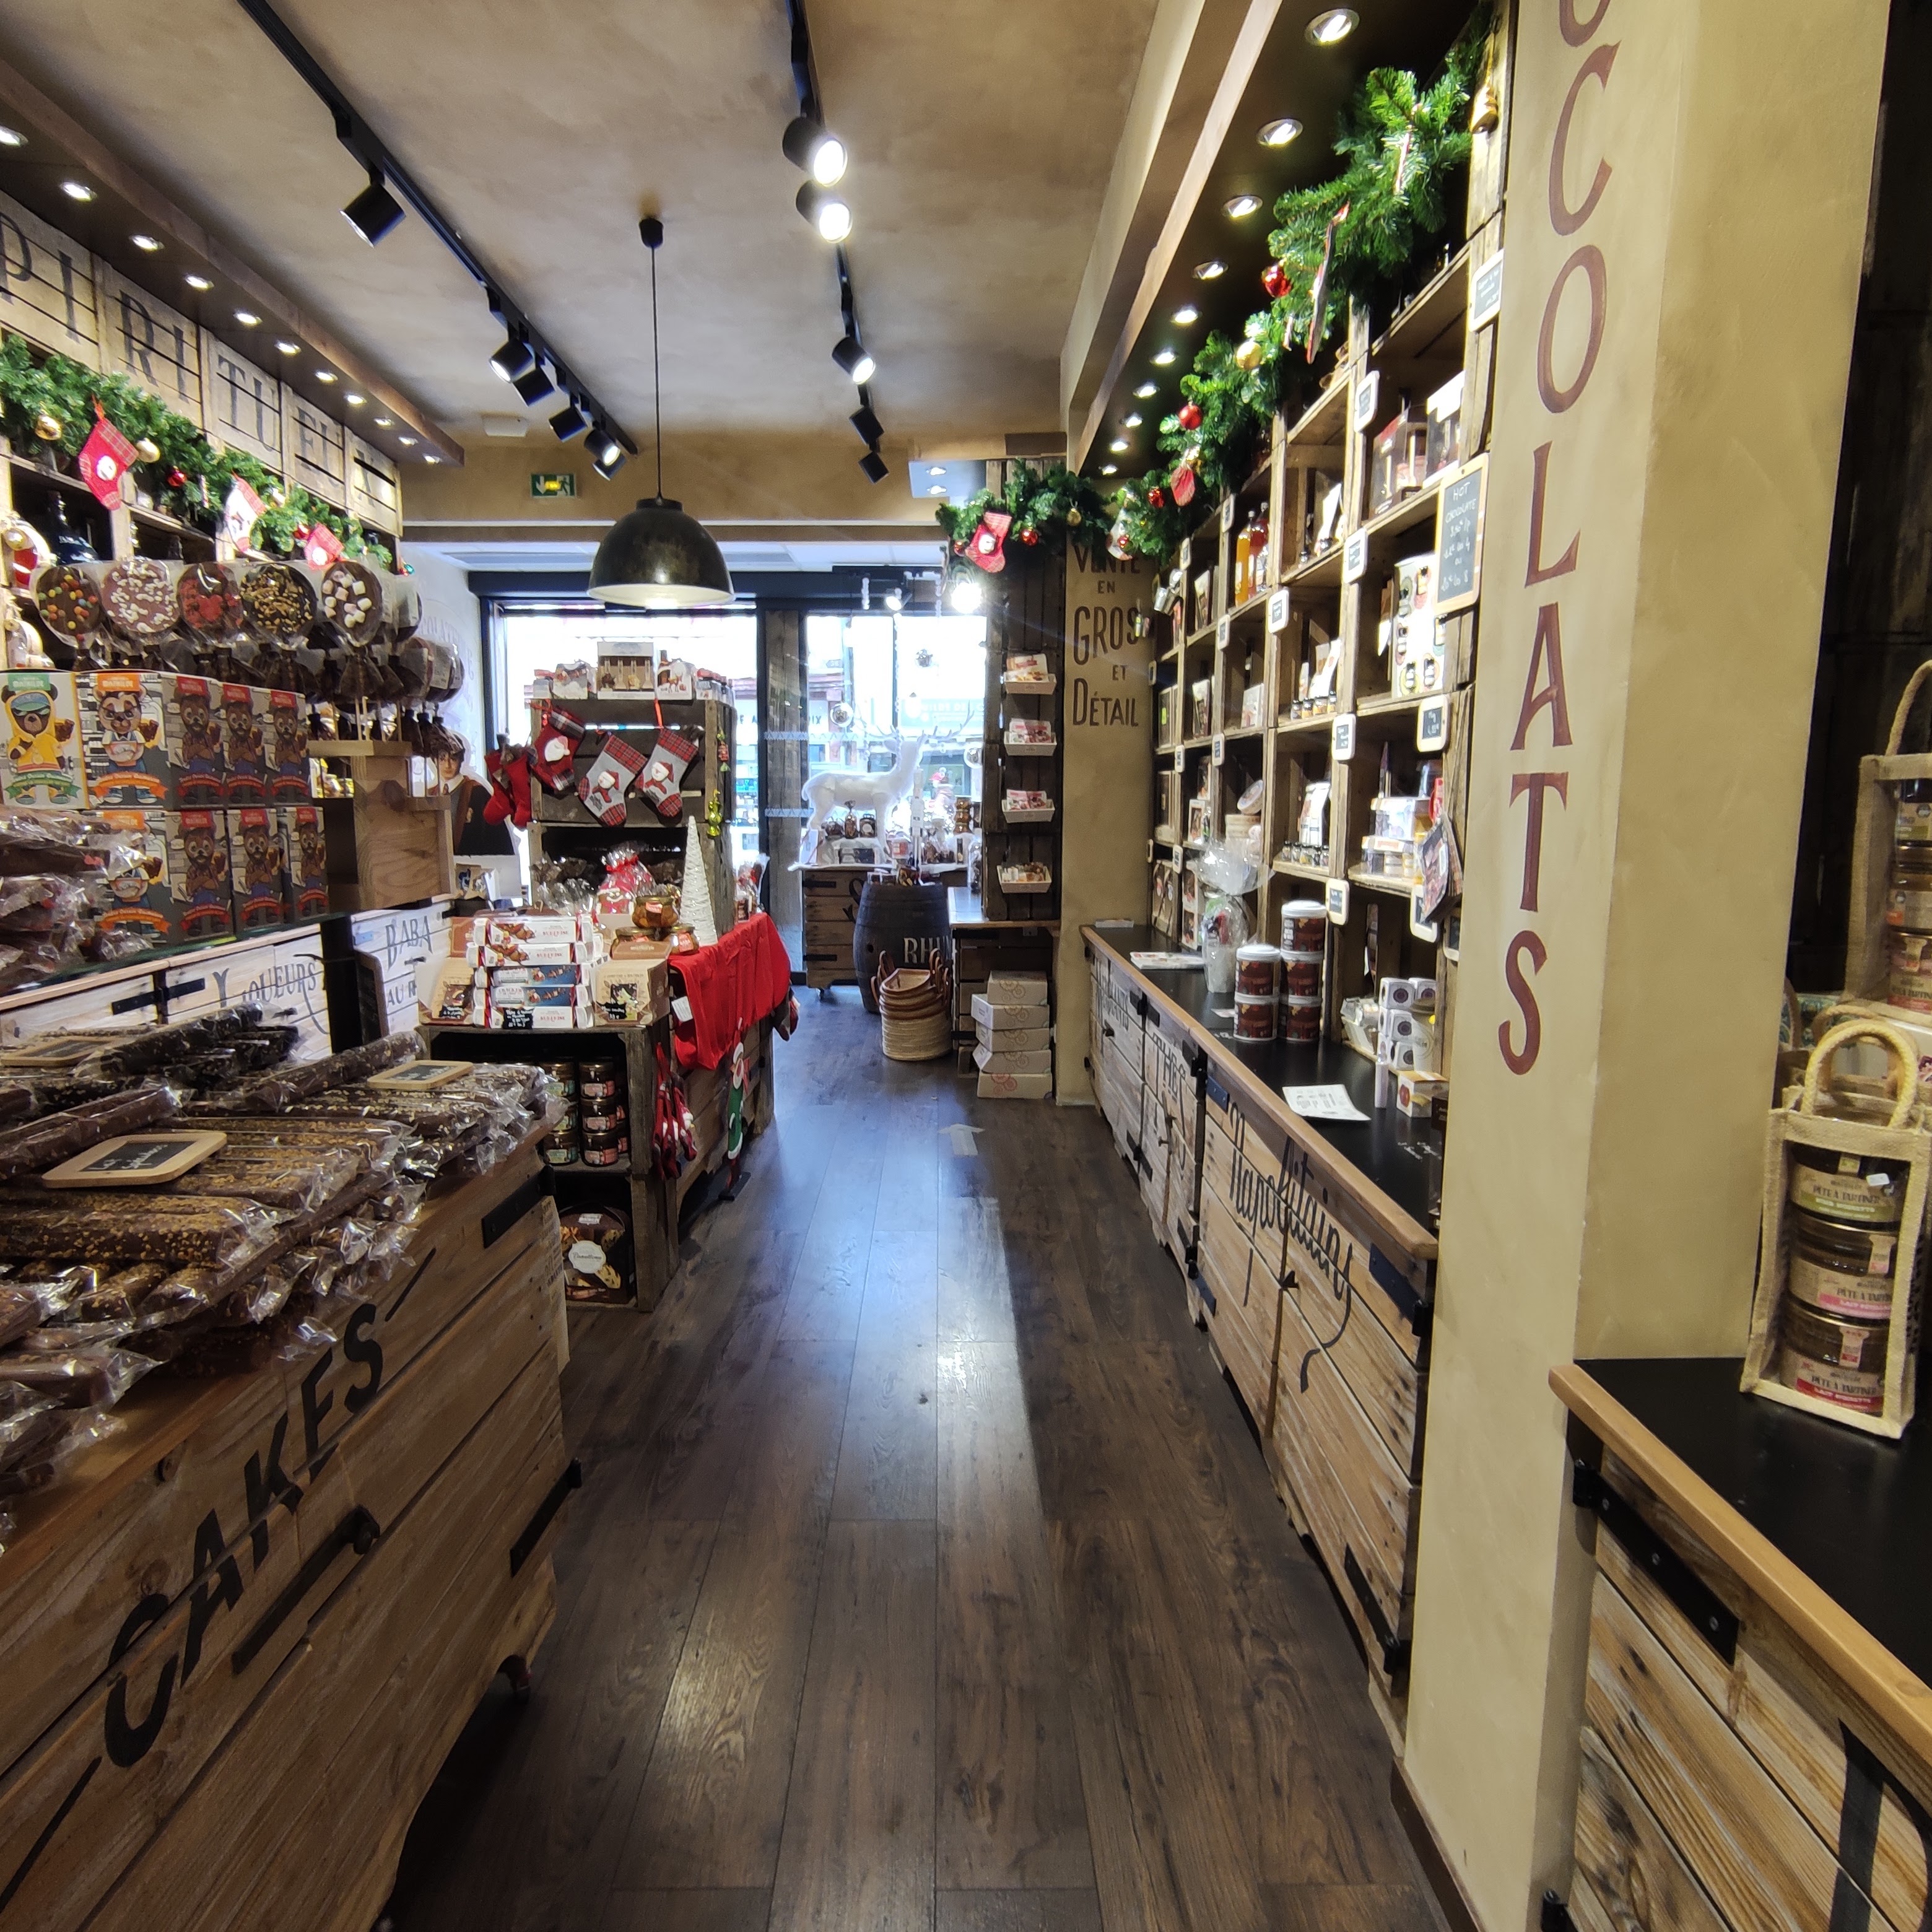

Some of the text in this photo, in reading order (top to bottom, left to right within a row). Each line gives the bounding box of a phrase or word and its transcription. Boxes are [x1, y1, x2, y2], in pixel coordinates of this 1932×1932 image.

[1453, 482, 1470, 500] HOT
[1499, 0, 1621, 1075] COLATS
[1097, 580, 1116, 594] EN
[1073, 606, 1139, 666] GROS
[1112, 664, 1127, 681] ET
[1073, 677, 1139, 727] DÉTAIL
[385, 915, 433, 972] BABA
[387, 985, 404, 1008] AU
[104, 1303, 384, 1767] CAKES
